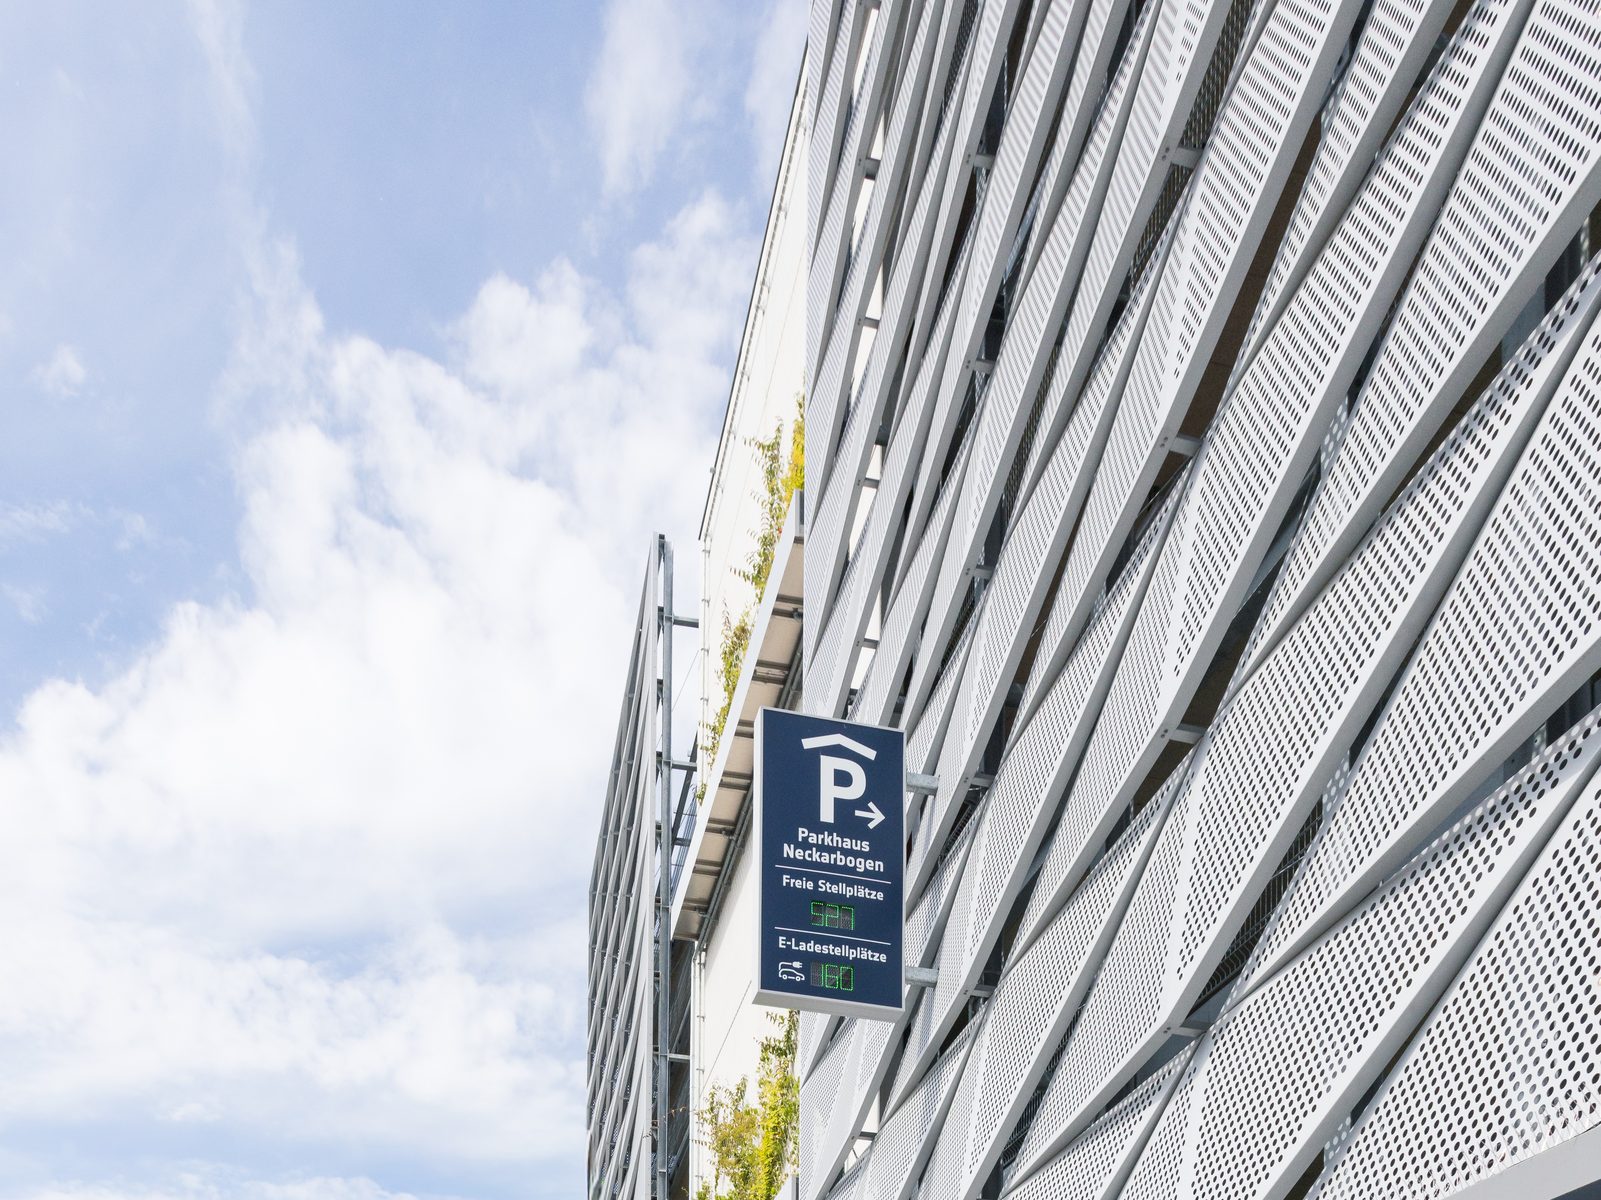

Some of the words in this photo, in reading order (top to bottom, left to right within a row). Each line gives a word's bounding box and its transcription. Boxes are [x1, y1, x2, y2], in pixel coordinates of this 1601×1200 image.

[819, 754, 867, 824] P
[798, 827, 870, 852] Parkhaus
[783, 843, 884, 872] Neckarbogen
[782, 875, 814, 890] Freie
[818, 880, 884, 901] Stellplätze
[811, 901, 854, 931] 527
[778, 936, 887, 963] E-Ladestellplätze
[821, 963, 854, 991] 160
